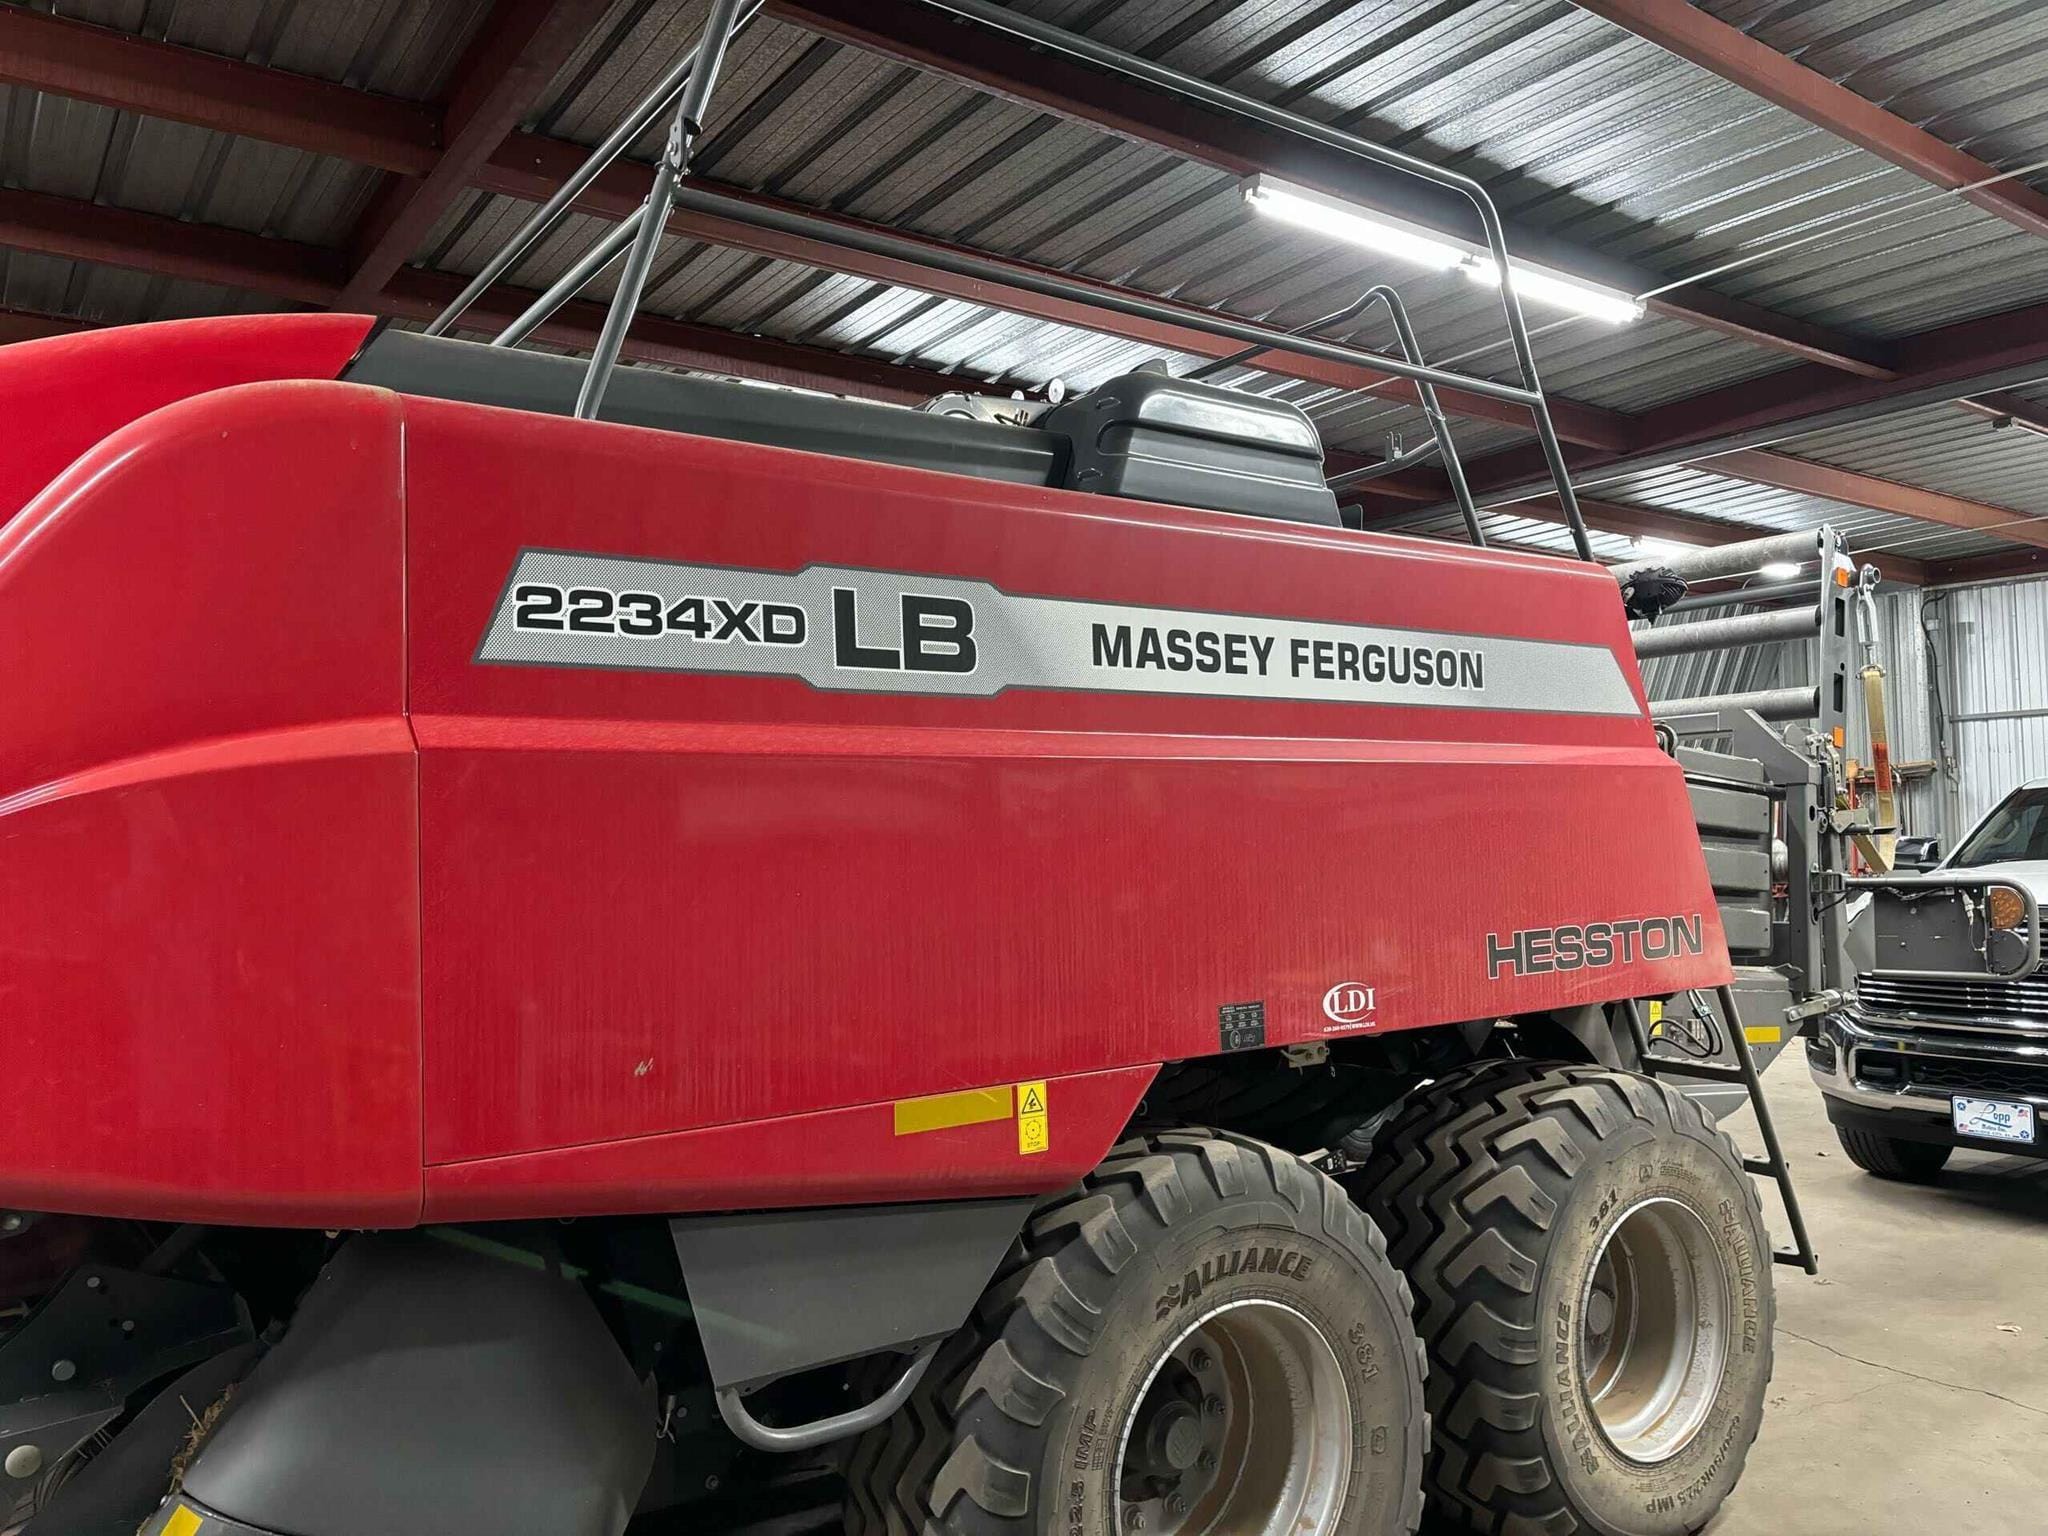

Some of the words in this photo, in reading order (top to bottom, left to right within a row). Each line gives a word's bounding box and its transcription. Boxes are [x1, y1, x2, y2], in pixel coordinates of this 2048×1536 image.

[514, 584, 806, 645] 2234XD
[832, 586, 978, 674] LB
[1091, 622, 1275, 677] MASSEY
[1290, 638, 1485, 689] FERGUSON
[1486, 913, 1703, 980] HESSTON
[1589, 1189, 1618, 1235] 381
[1180, 1246, 1314, 1309] ALLIANCE
[1723, 1222, 1759, 1355] ALLIANCE
[1348, 1322, 1379, 1384] 381
[1555, 1301, 1591, 1451] ALLIANCE
[1645, 1495, 1675, 1514] IMP
